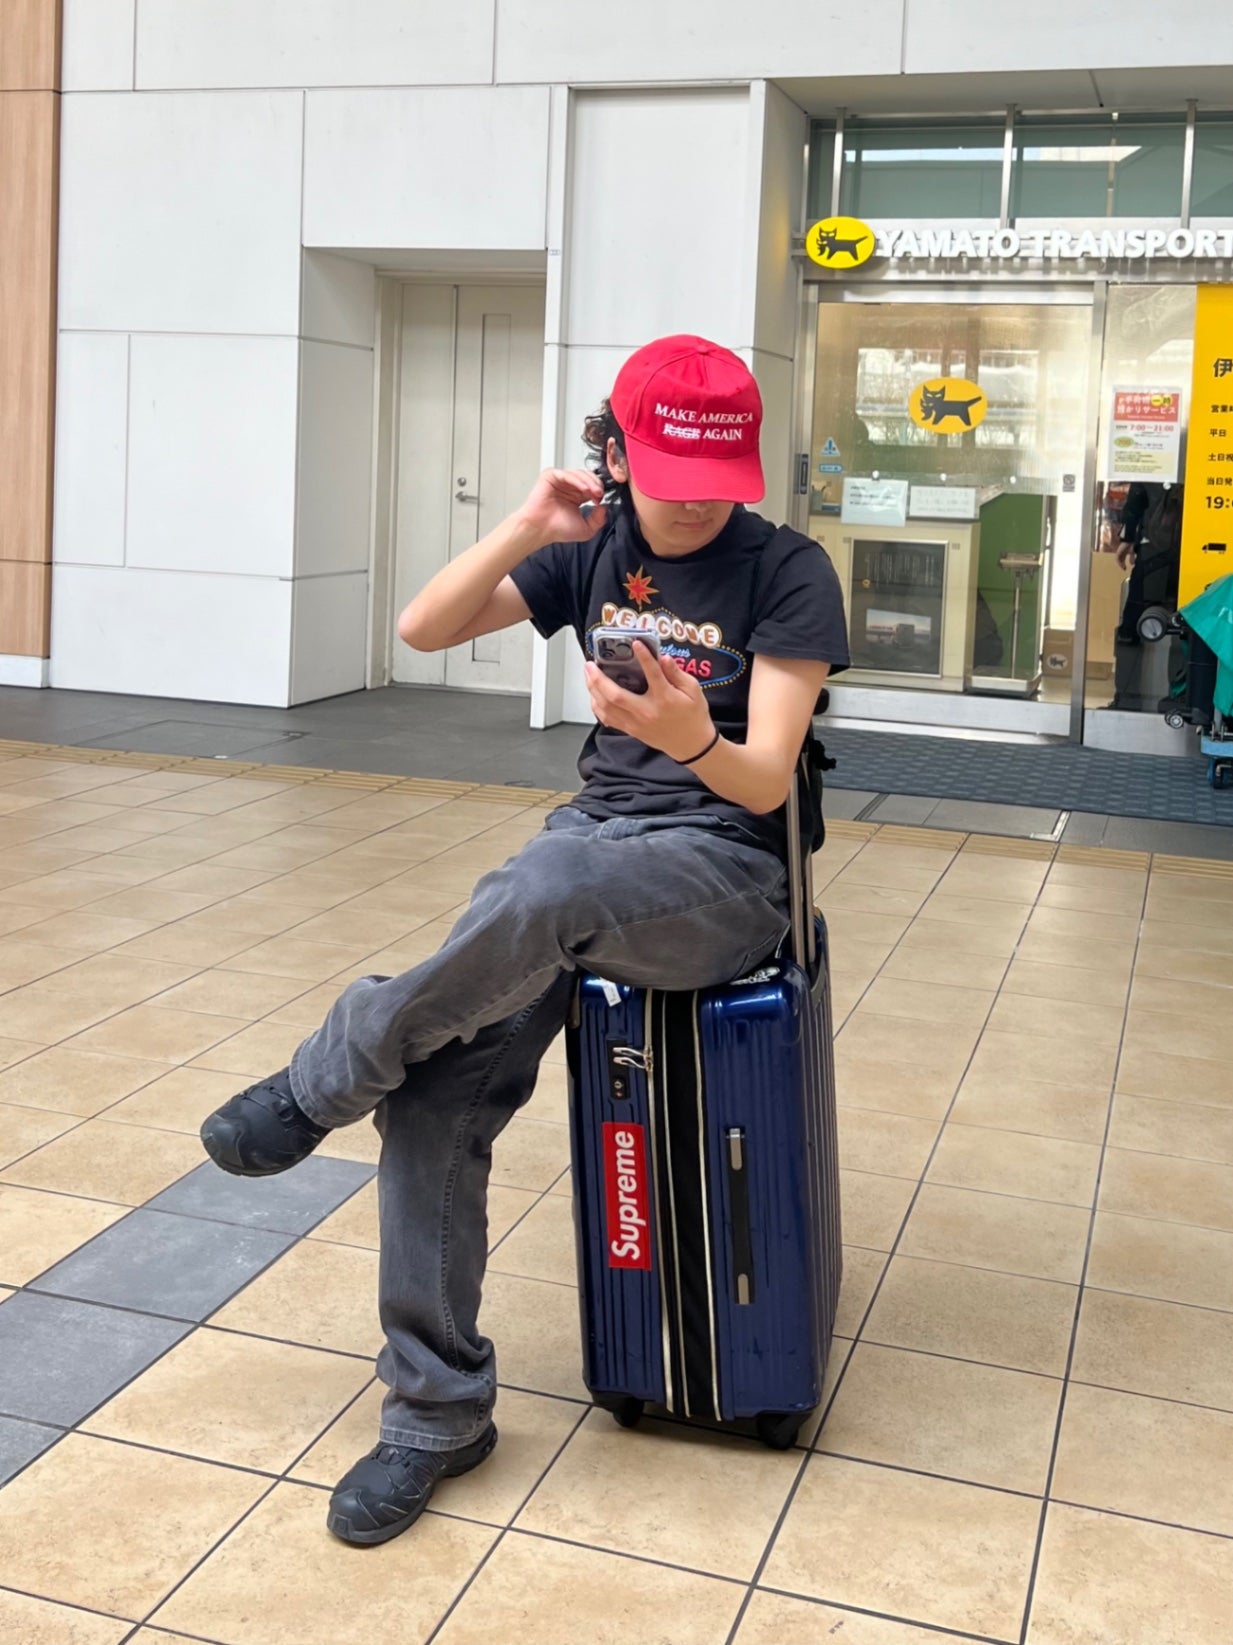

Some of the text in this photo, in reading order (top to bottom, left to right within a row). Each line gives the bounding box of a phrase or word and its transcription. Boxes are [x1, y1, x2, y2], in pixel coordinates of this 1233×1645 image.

[876, 228, 1233, 258] YAMATO TRANSPORT
[1213, 358, 1233, 378] 伊
[655, 402, 753, 424] MAKE AMERICA
[703, 428, 742, 440] AGAIN
[1209, 428, 1227, 438] 平日
[1206, 495, 1233, 510] 19:
[601, 605, 718, 646] WELCOME
[673, 655, 713, 679] GAS
[611, 1130, 647, 1261] Supreme
